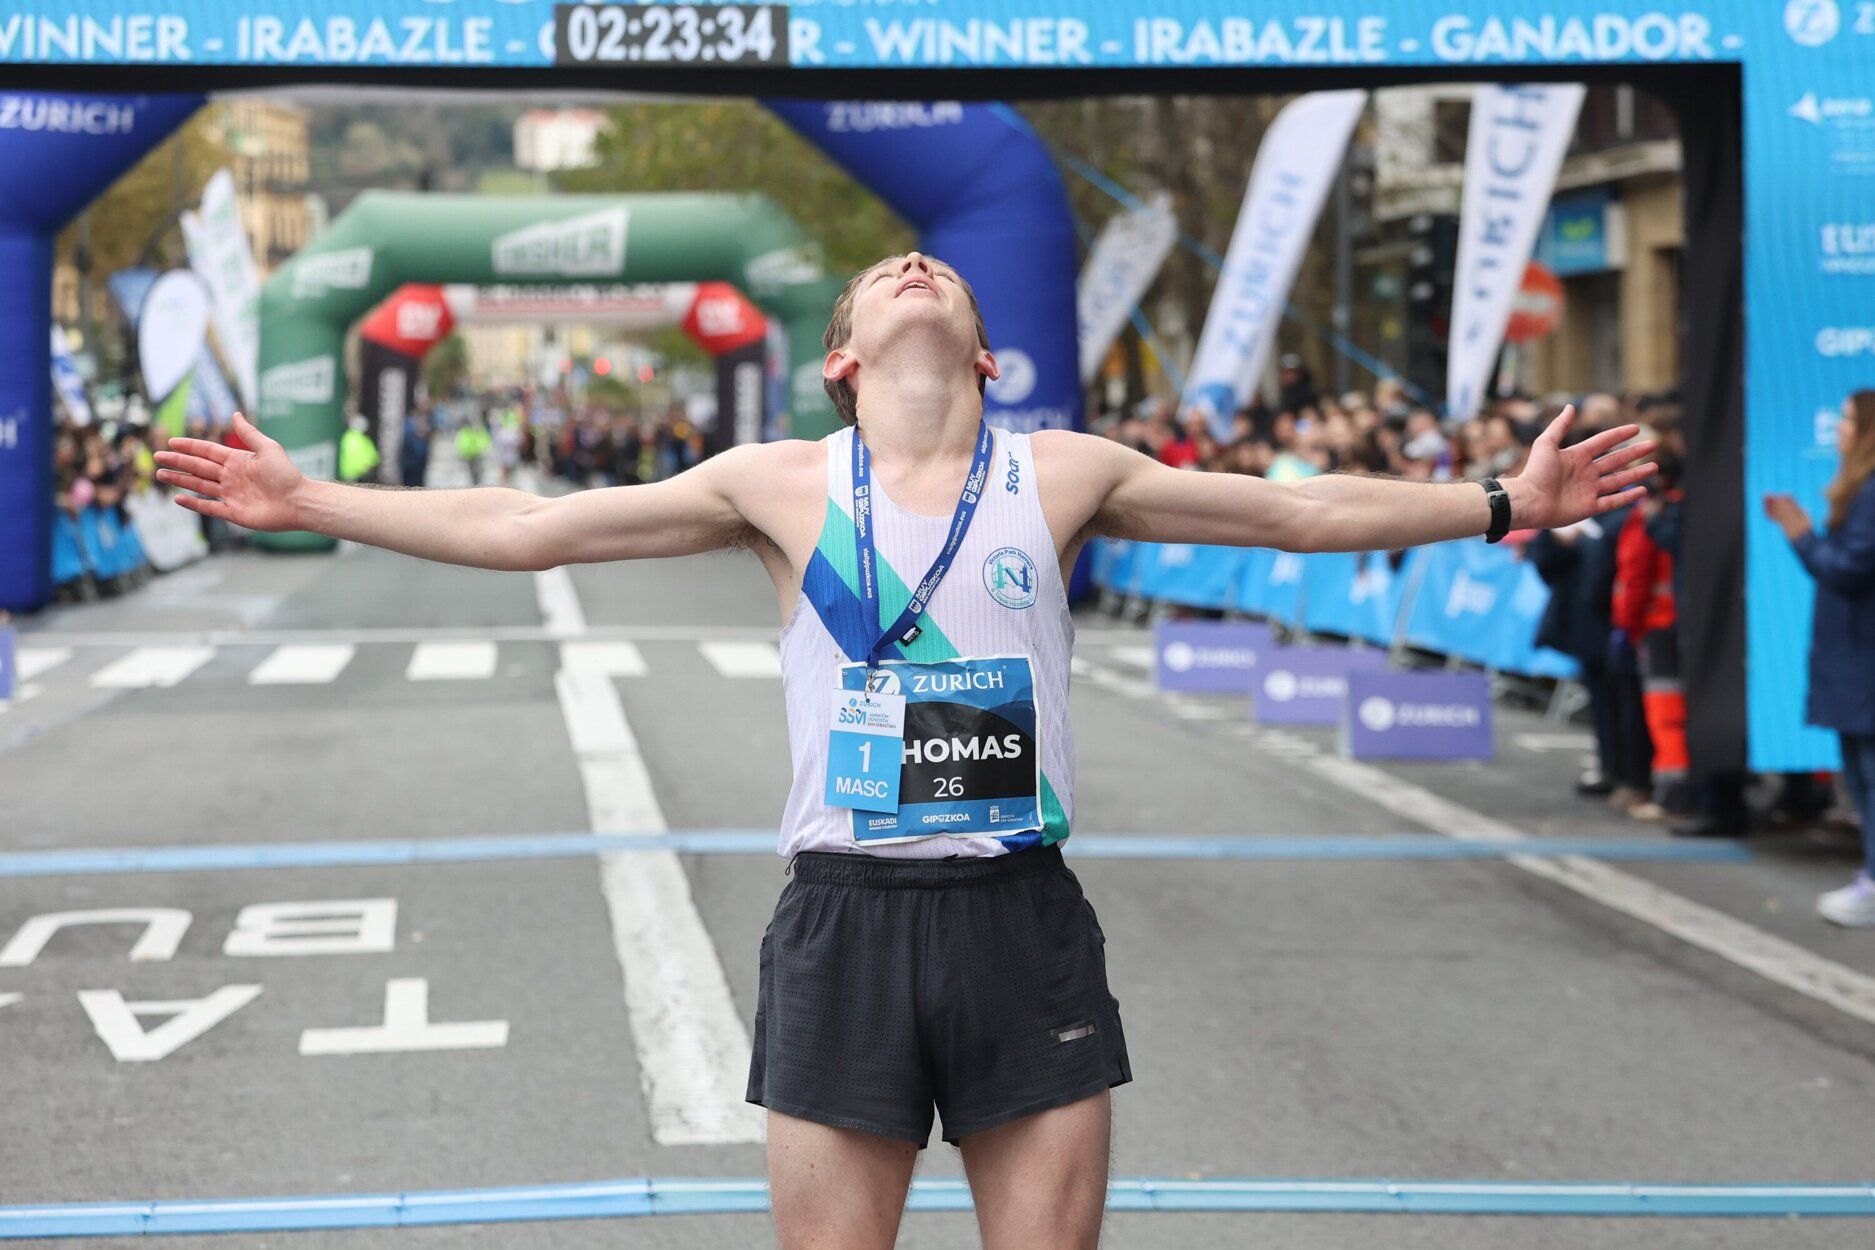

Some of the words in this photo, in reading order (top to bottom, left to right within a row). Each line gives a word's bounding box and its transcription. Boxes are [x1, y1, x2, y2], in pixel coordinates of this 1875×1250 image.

[236, 16, 495, 63] IRABAZLE
[567, 5, 776, 62] 02:23:34
[864, 17, 1093, 64] WINNER
[1133, 17, 1388, 64] IRABAZLE
[1430, 14, 1714, 63] GANADOR
[0, 95, 135, 134] ZURICH
[1815, 327, 1875, 357] GIP
[1005, 451, 1019, 495] soar
[916, 580, 928, 599] MUY
[919, 565, 944, 601] GIPUZKOA
[913, 672, 1004, 693] ZURICH
[859, 742, 871, 772] 1
[901, 733, 1022, 766] HOMAS
[836, 776, 888, 798] MASC
[932, 776, 964, 798] 26
[0, 978, 510, 1062] TA
